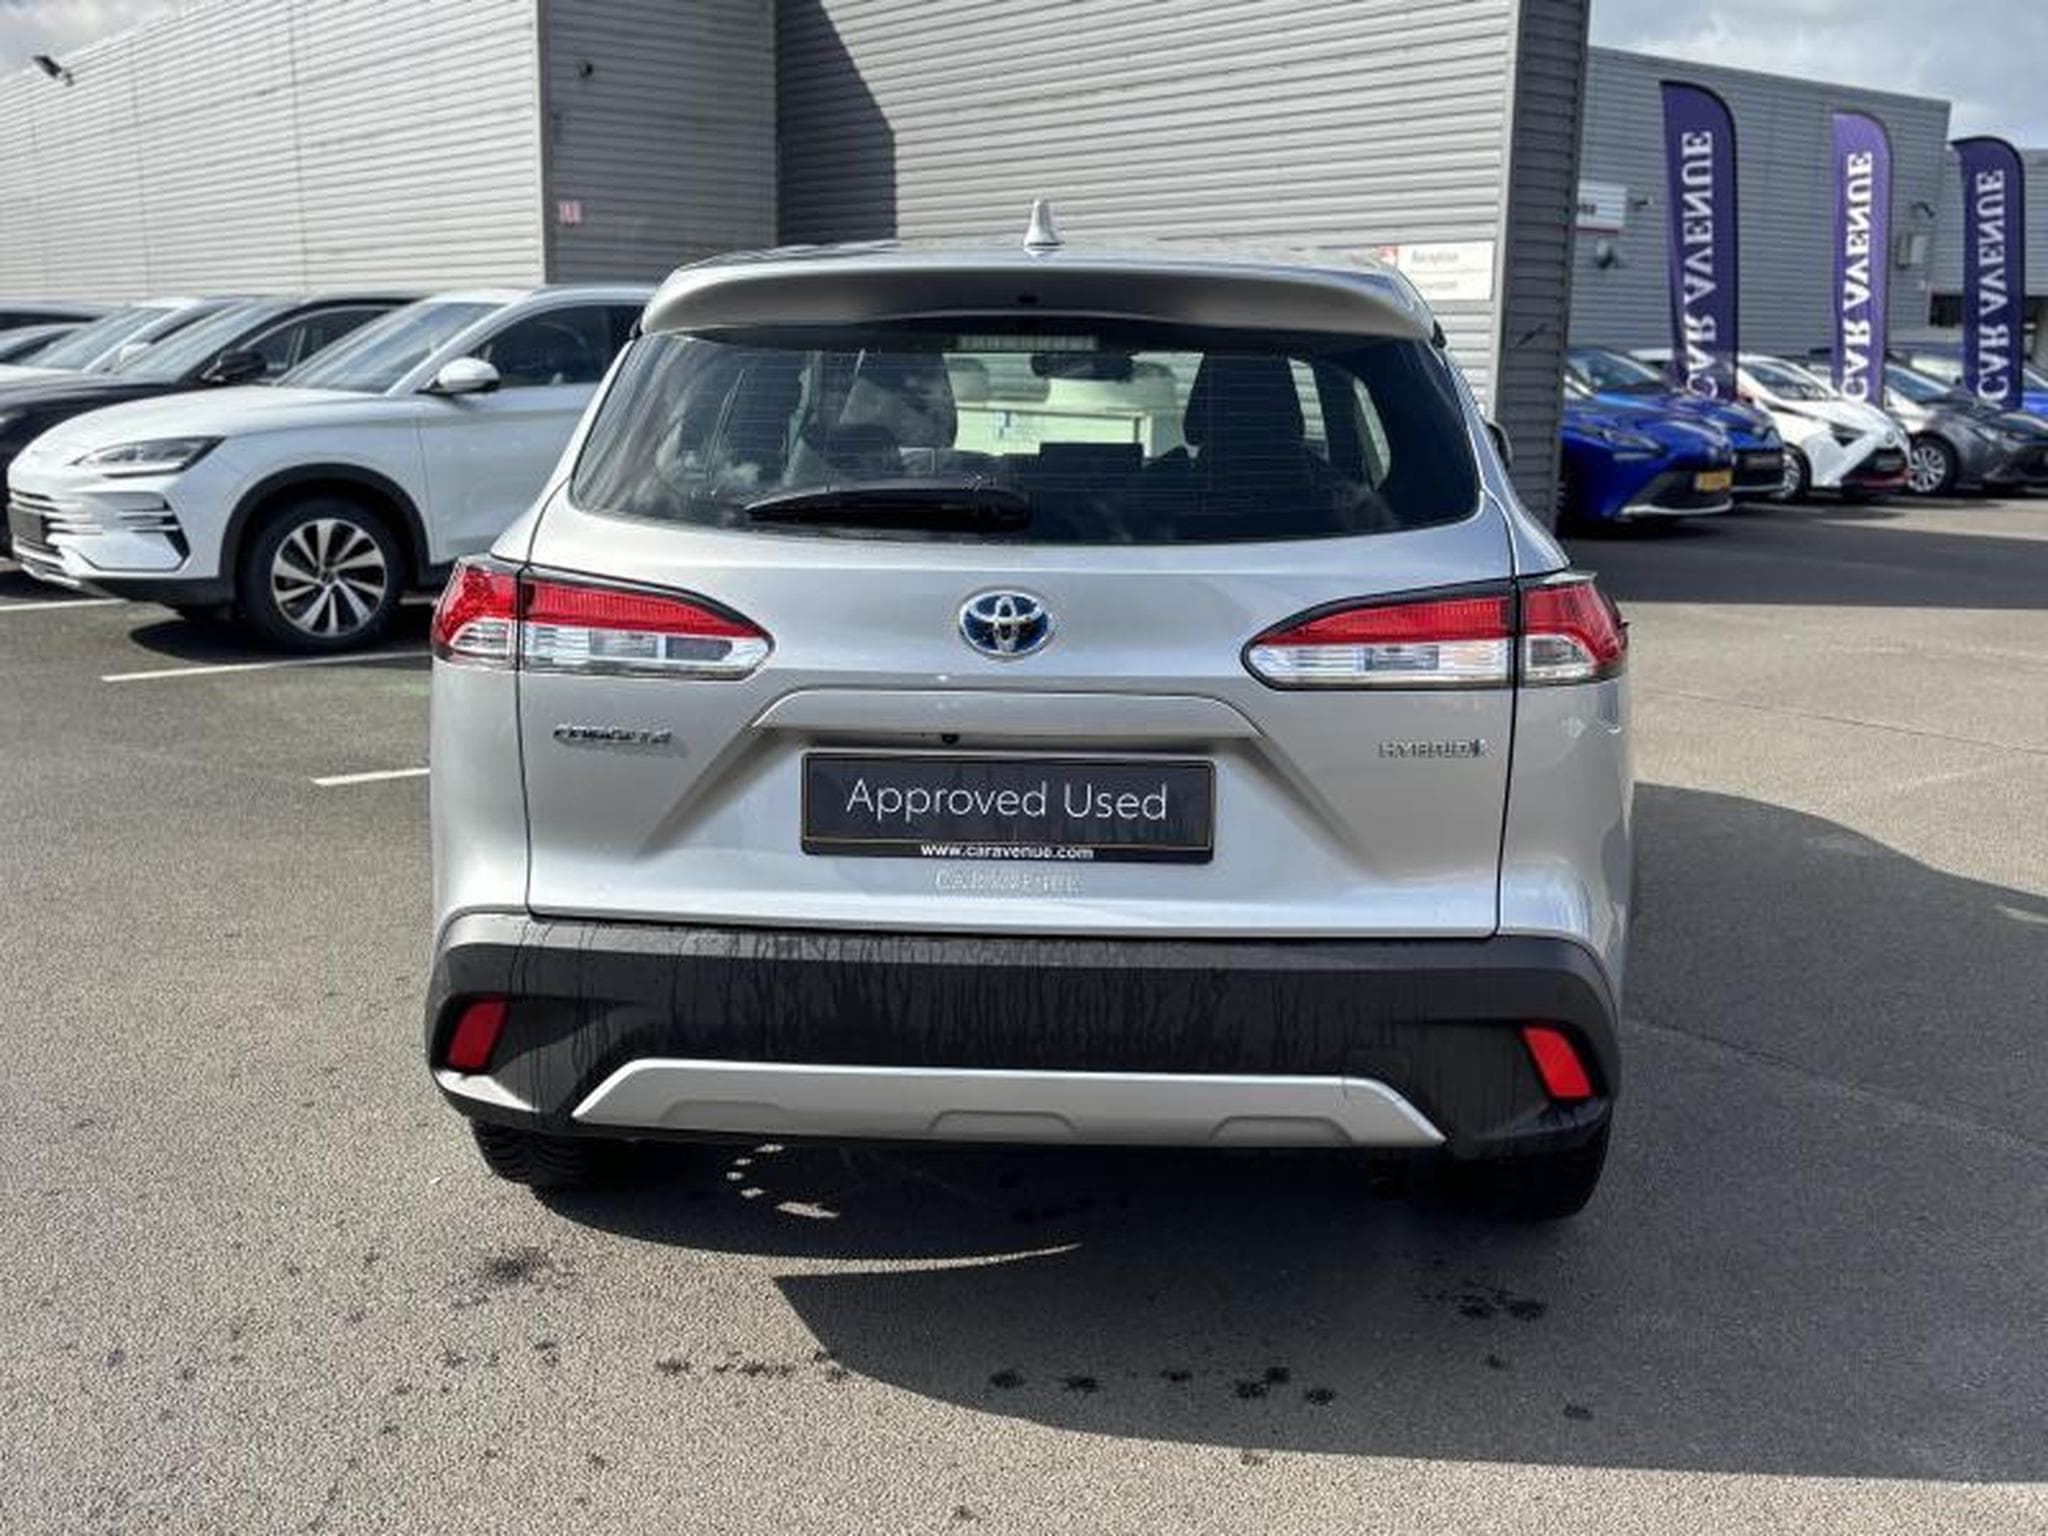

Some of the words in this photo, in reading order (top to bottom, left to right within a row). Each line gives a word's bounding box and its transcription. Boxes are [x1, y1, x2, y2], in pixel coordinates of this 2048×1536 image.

[846, 778, 1047, 823] Approved
[1064, 783, 1168, 821] Used
[920, 843, 1095, 861] www.caravenue.com
